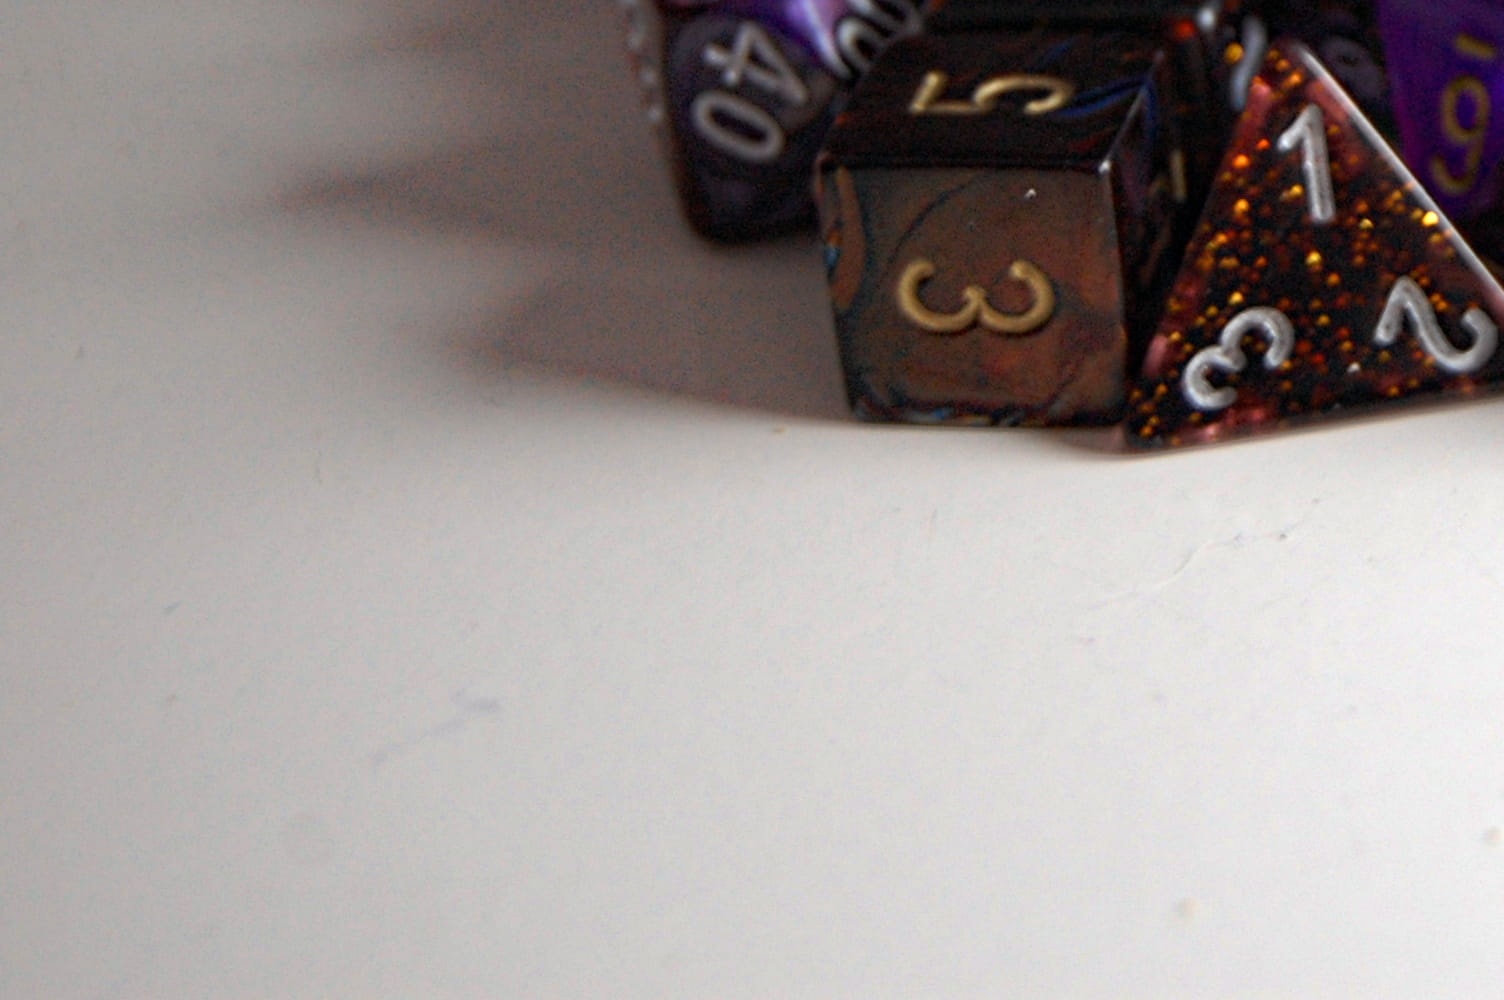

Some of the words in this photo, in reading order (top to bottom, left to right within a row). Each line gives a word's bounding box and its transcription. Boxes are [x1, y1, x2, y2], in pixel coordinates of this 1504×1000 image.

[690, 18, 810, 162] 40
[1277, 104, 1336, 224] 1
[899, 257, 1056, 335] 3
[1374, 276, 1497, 374] 2
[1182, 306, 1295, 409] 3
